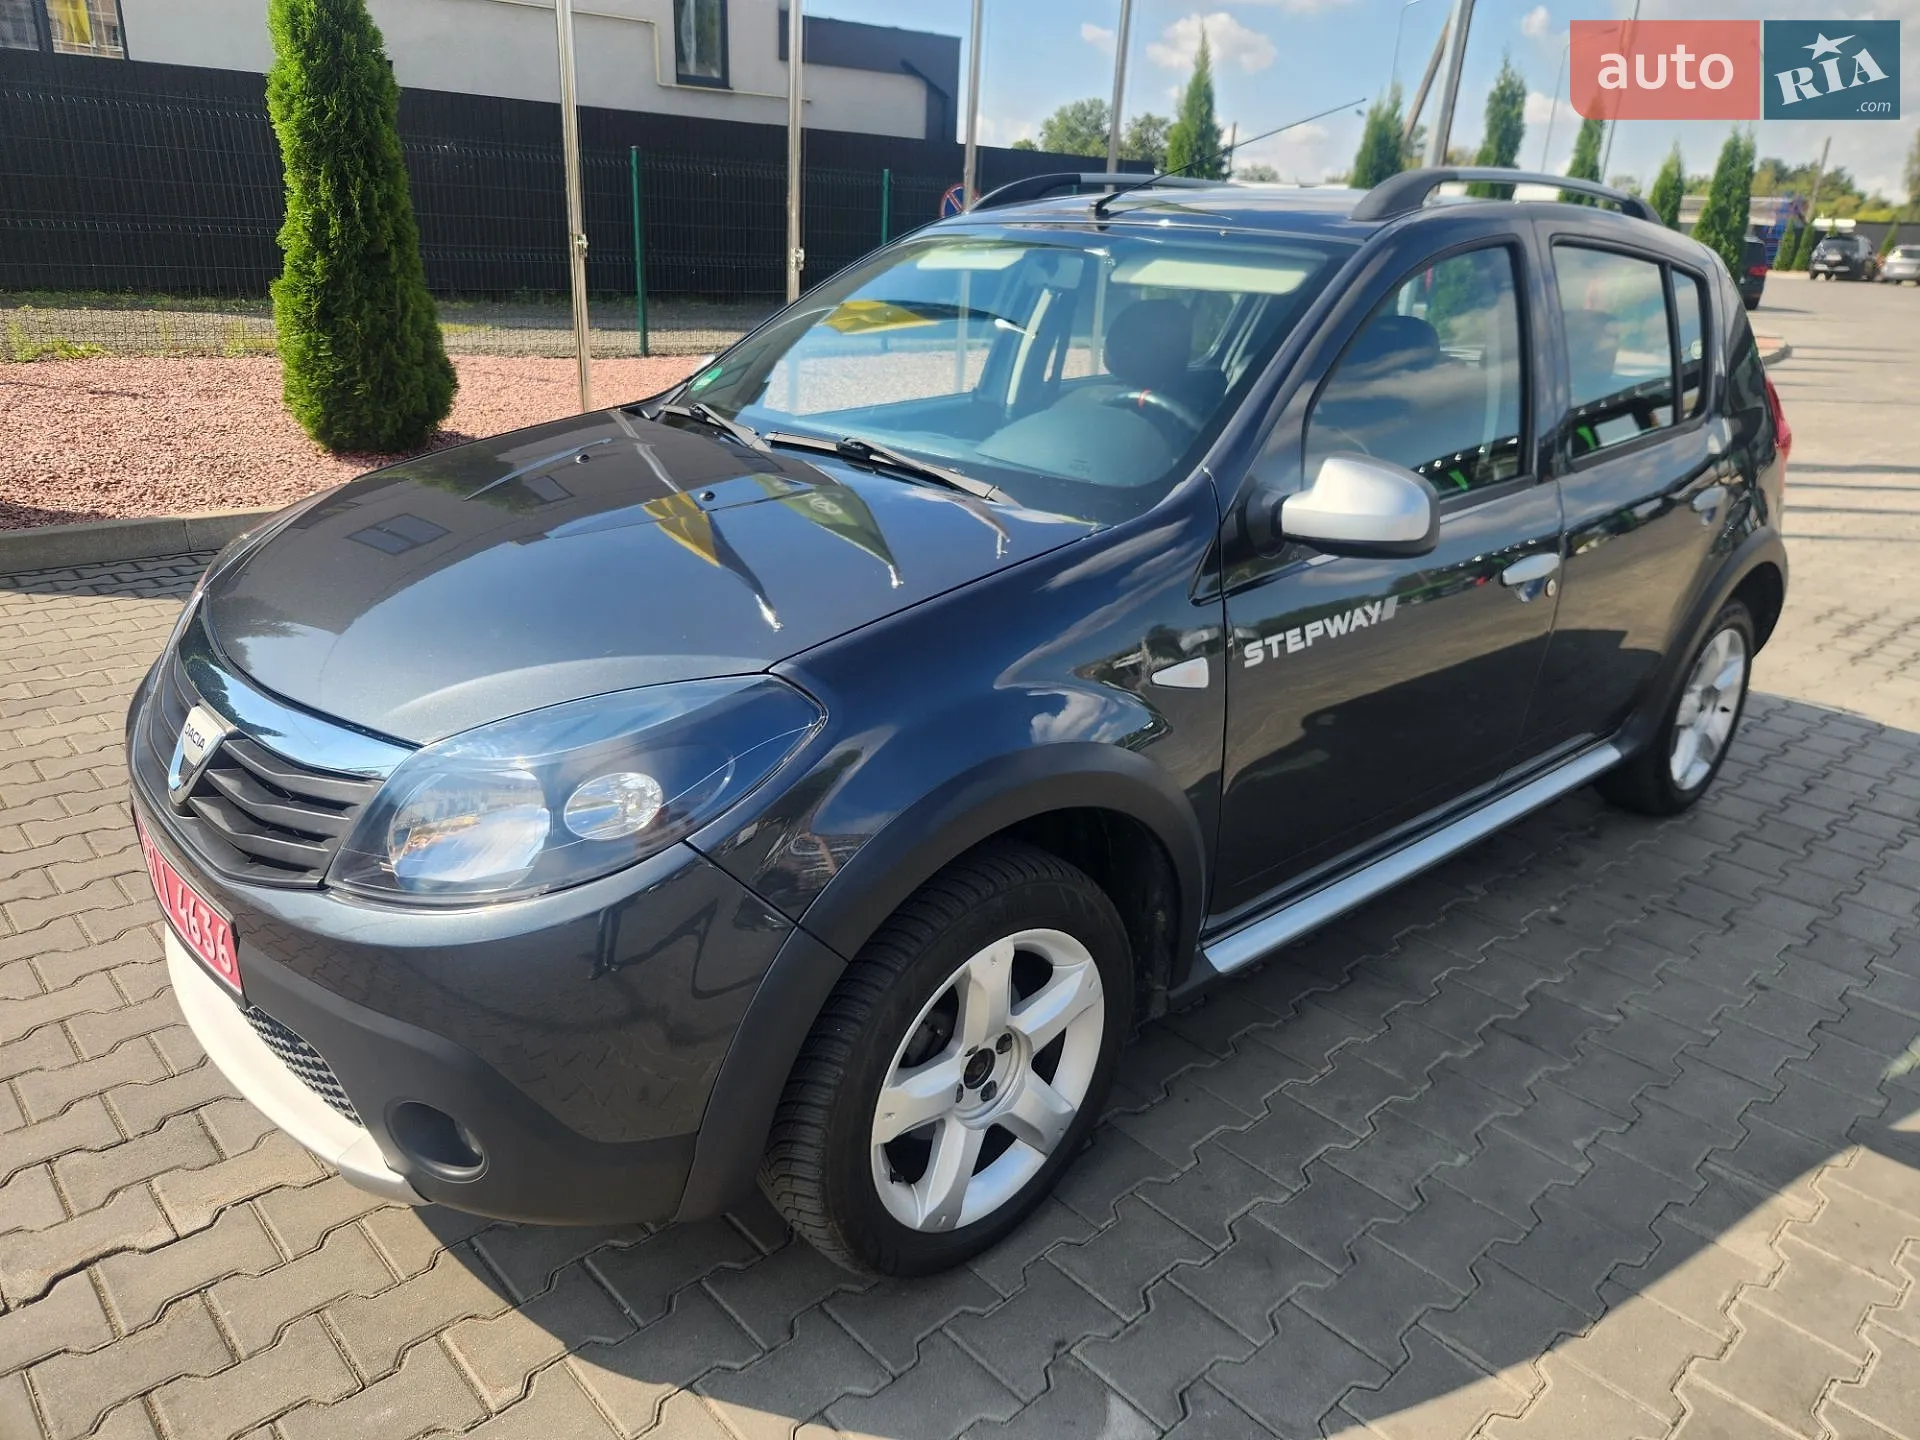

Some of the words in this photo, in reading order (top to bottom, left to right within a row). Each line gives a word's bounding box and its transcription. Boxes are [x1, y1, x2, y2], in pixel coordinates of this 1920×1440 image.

[1243, 600, 1382, 669] STEPWAY
[184, 723, 206, 751] DACIA
[176, 883, 232, 974] 4636
